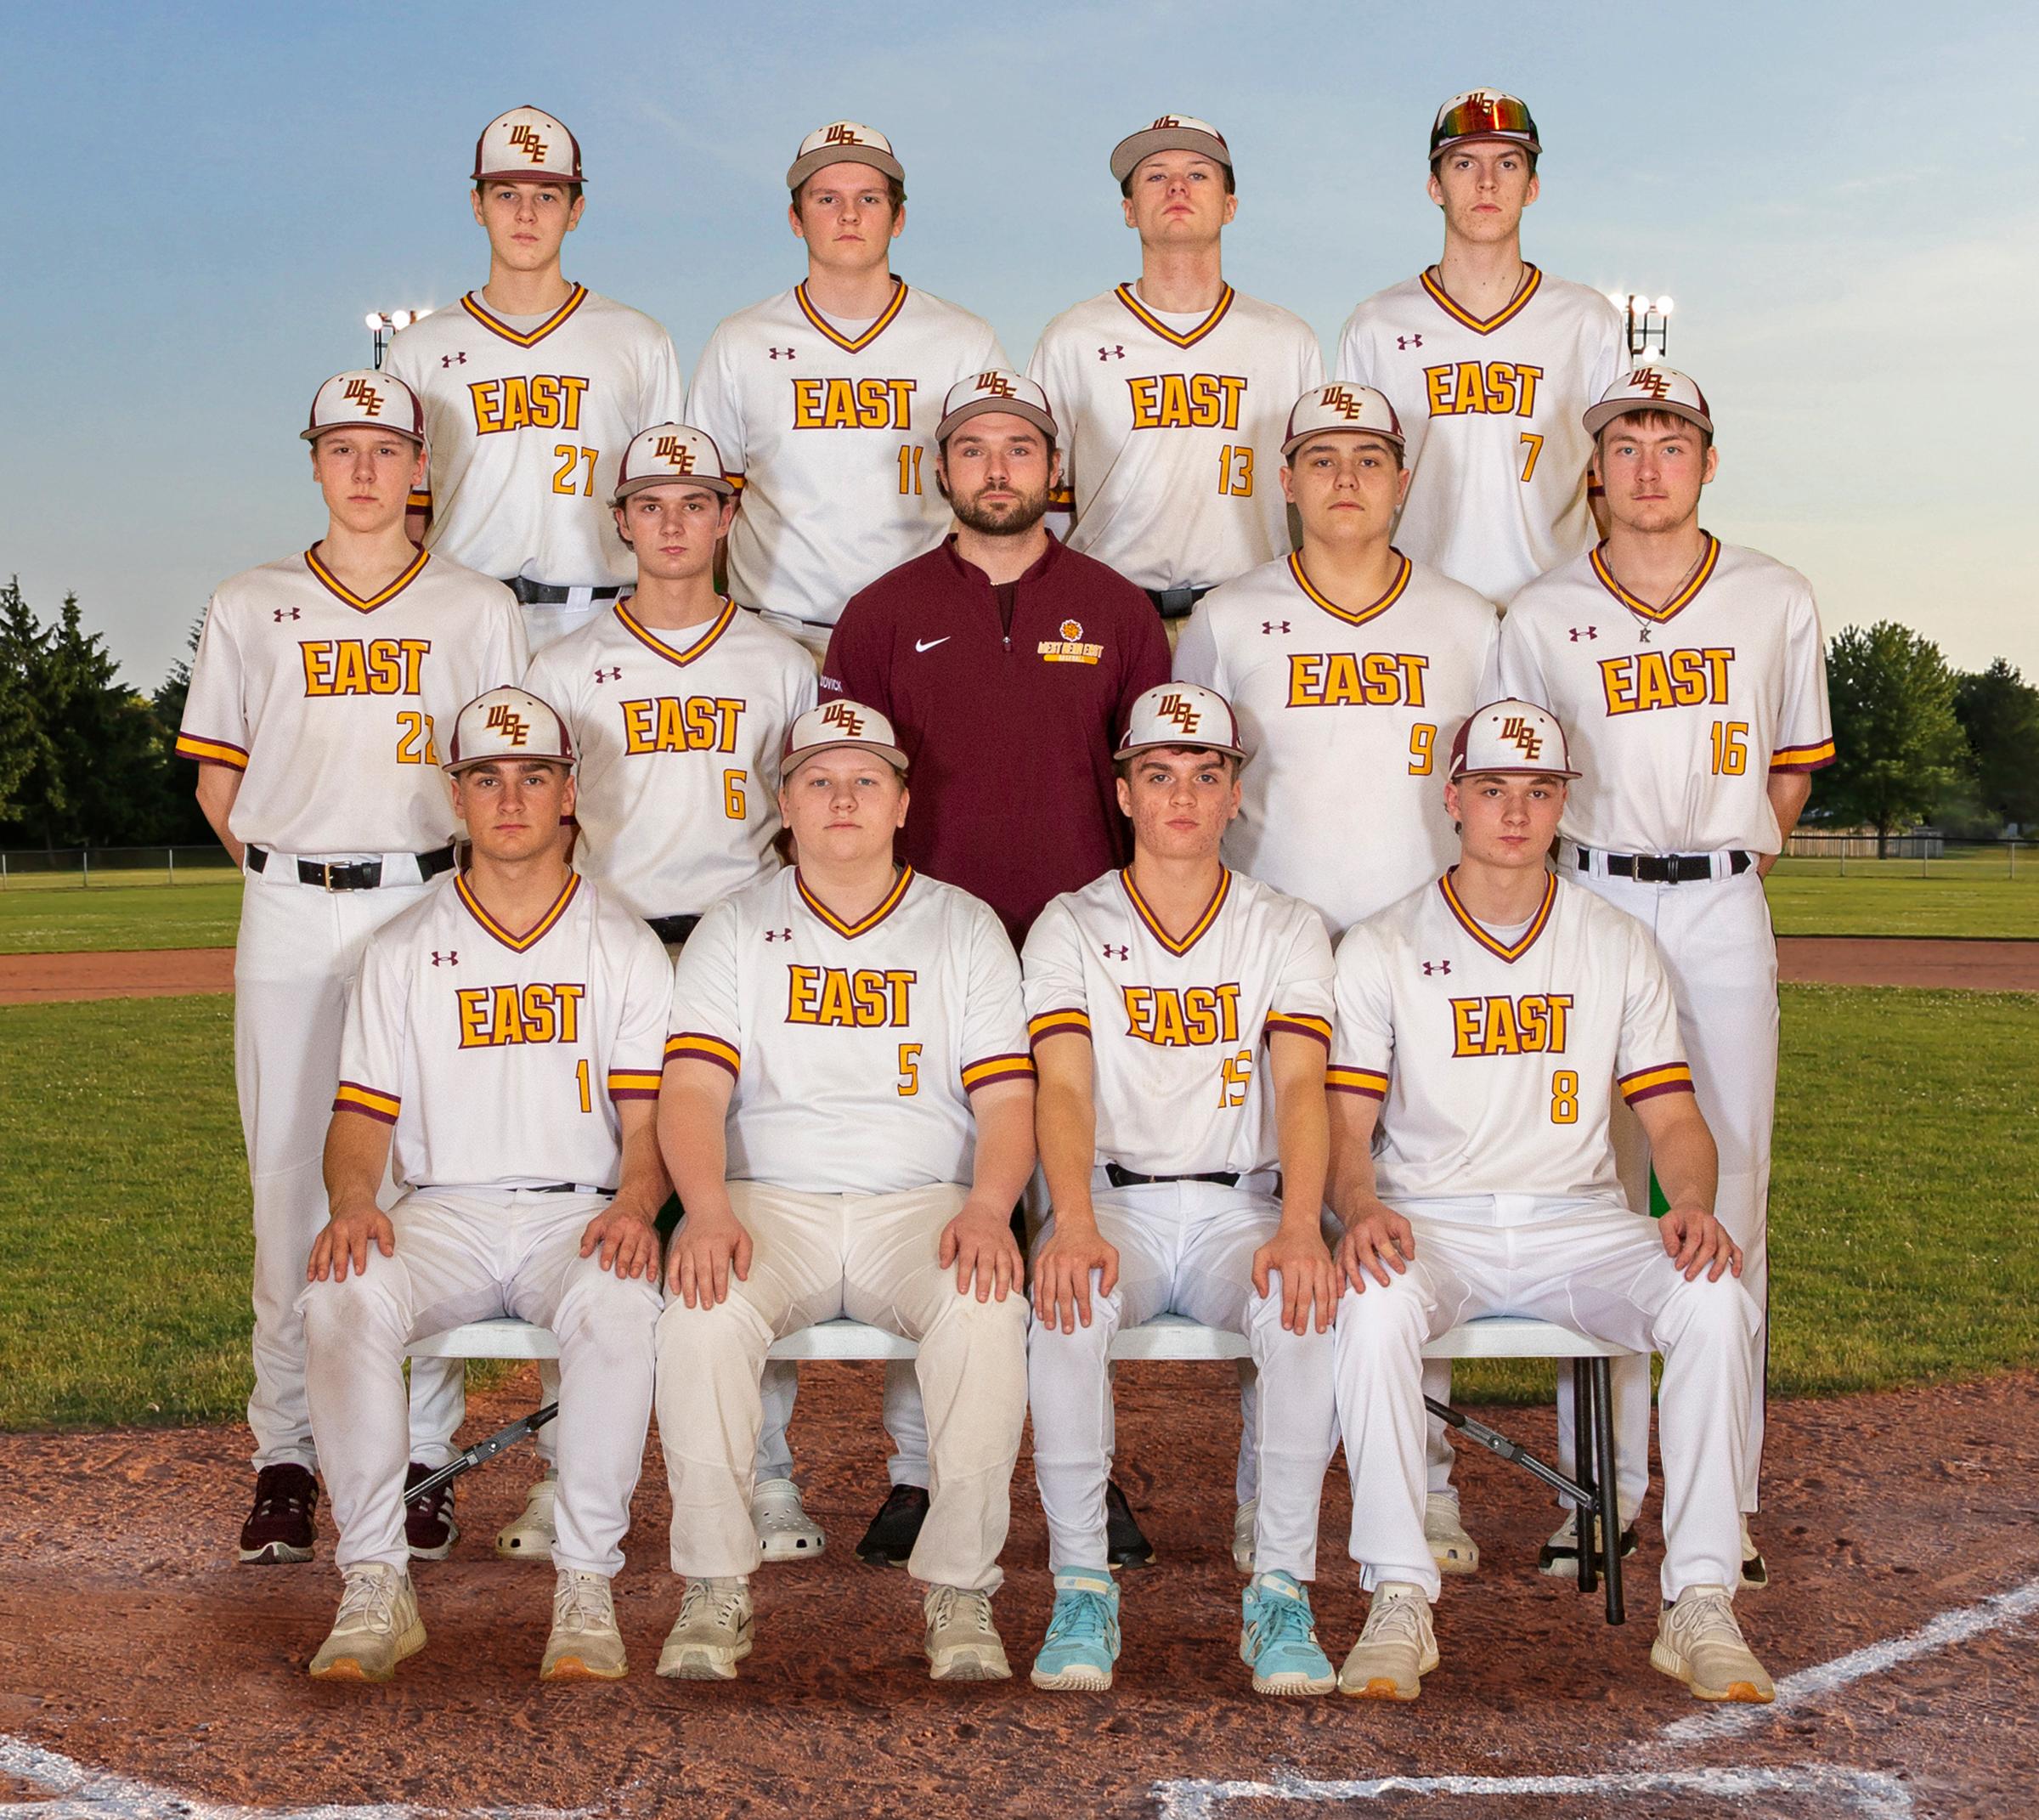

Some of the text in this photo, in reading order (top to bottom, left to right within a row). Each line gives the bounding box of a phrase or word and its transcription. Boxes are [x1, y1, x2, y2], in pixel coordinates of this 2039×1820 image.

[508, 125, 548, 163] WBE
[342, 379, 383, 416] WBE
[468, 376, 589, 436] EAST
[792, 378, 917, 430] EAST
[1126, 373, 1247, 430] EAST
[1320, 386, 1362, 420] WBE
[1424, 361, 1543, 419] EAST
[1628, 367, 1670, 399] WBE
[552, 444, 599, 497] 27
[652, 436, 696, 476] WBE
[898, 444, 923, 495] 11
[1217, 444, 1255, 498] 13
[1520, 432, 1544, 483] 7
[299, 639, 431, 698] EAST
[1286, 652, 1429, 708] EAST
[1597, 647, 1735, 717] EAST
[485, 704, 530, 746] WBE
[620, 696, 746, 756] EAST
[822, 704, 865, 737] WBE
[1157, 693, 1201, 733] WBE
[1500, 717, 1542, 760] WBE
[1409, 722, 1437, 776] 9
[1710, 721, 1748, 776] 16
[723, 769, 747, 820] 6
[455, 983, 585, 1049] EAST
[785, 964, 917, 1028] EAST
[1122, 982, 1241, 1048] EAST
[1449, 993, 1573, 1058] EAST
[575, 1059, 592, 1113] 1
[897, 1043, 923, 1097] 5
[1217, 1049, 1252, 1109] 15
[1551, 1071, 1579, 1124] 8
